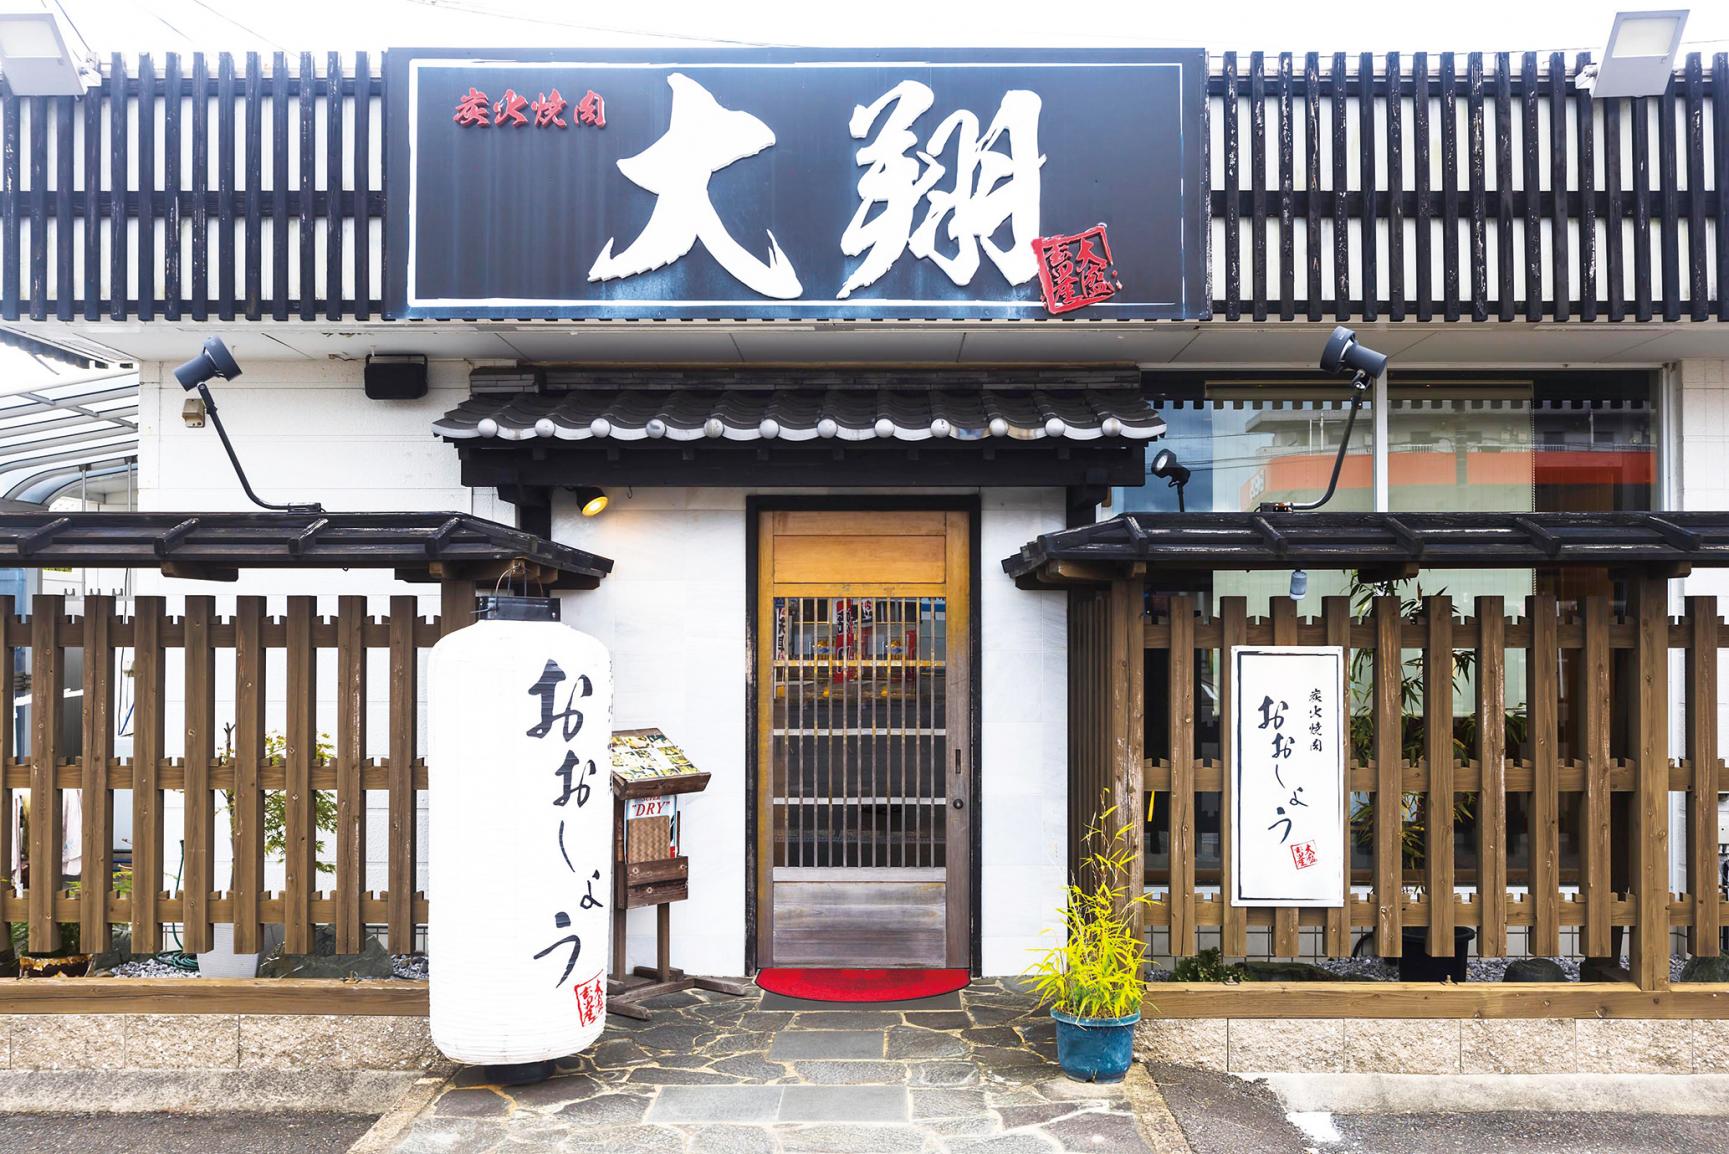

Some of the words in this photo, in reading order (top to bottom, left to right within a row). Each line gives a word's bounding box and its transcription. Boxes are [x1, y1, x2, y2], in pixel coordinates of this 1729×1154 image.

[453, 87, 607, 128] 炭火焼肉
[587, 72, 1047, 300] 大翔
[1257, 695, 1309, 845] おおしょう
[1309, 687, 1323, 753] 炭火焼肉
[525, 658, 605, 989] おおしょう
